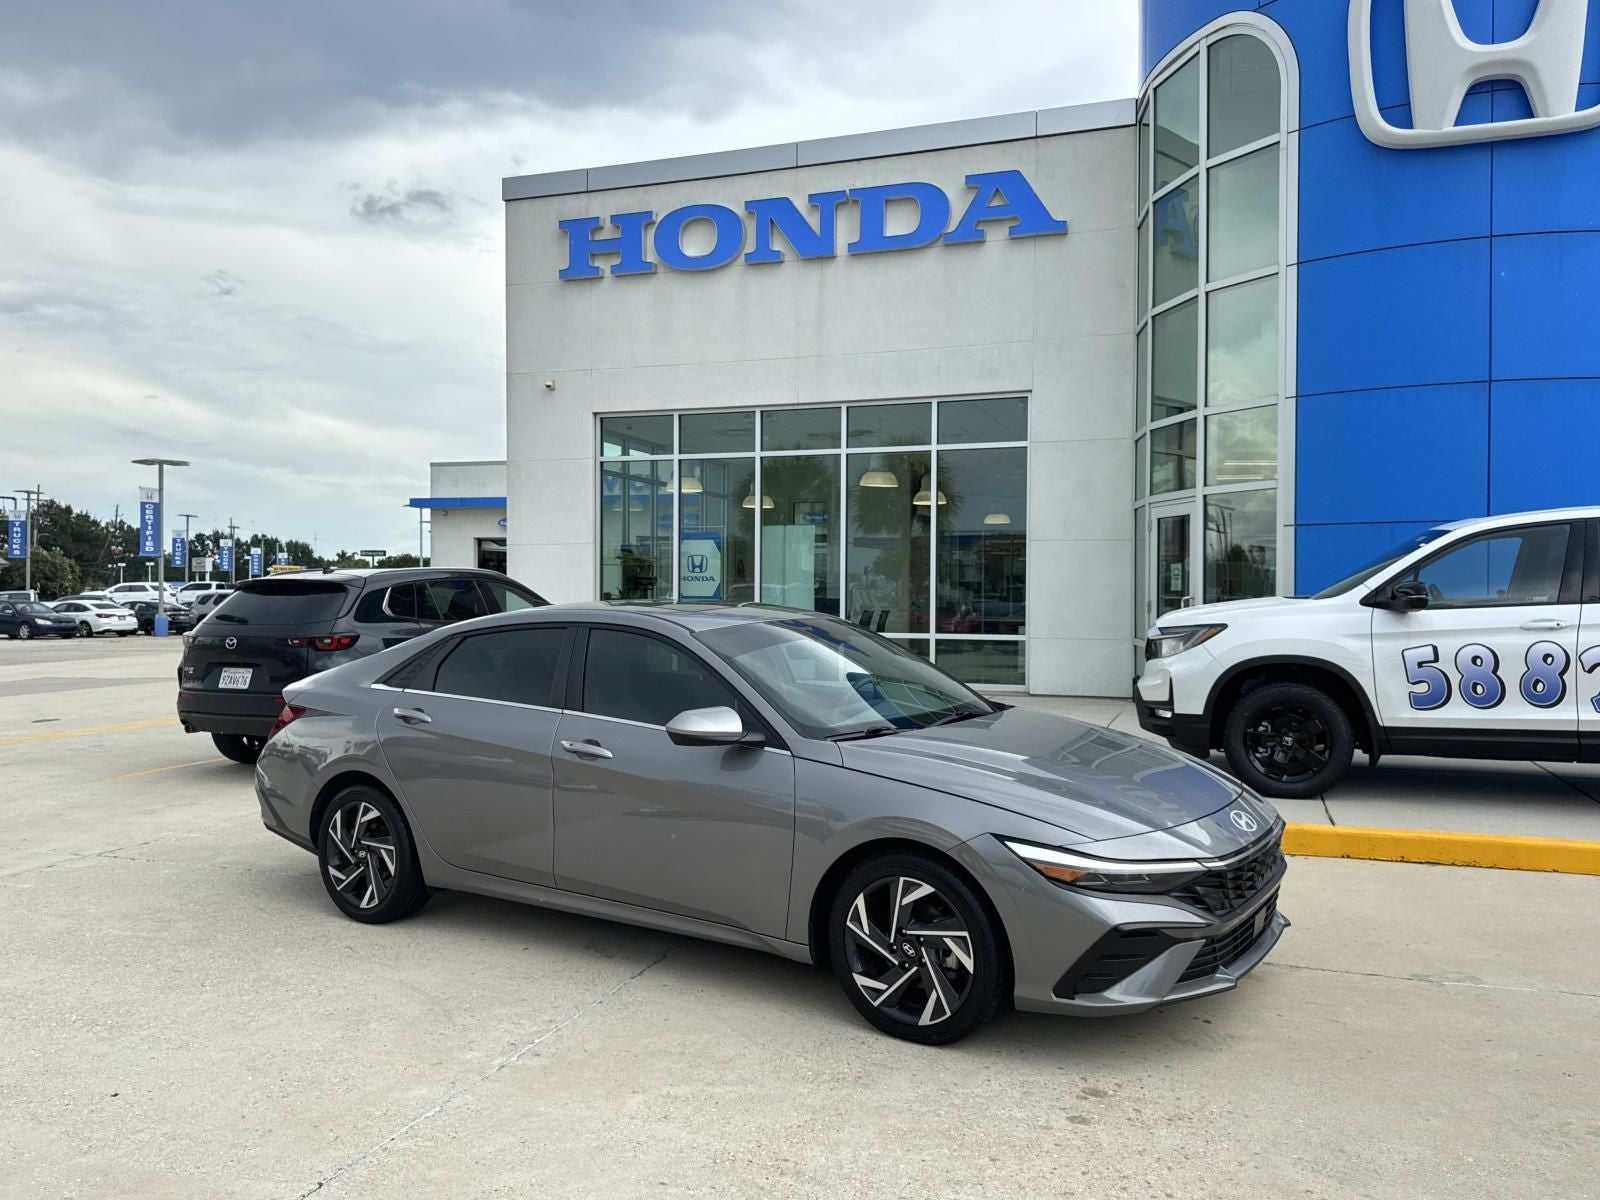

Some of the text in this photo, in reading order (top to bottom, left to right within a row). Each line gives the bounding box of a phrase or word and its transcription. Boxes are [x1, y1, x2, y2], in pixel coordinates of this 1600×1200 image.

[558, 169, 1068, 281] HONDA
[13, 521, 21, 555] TRUCKS
[145, 504, 154, 552] CERTIFIED
